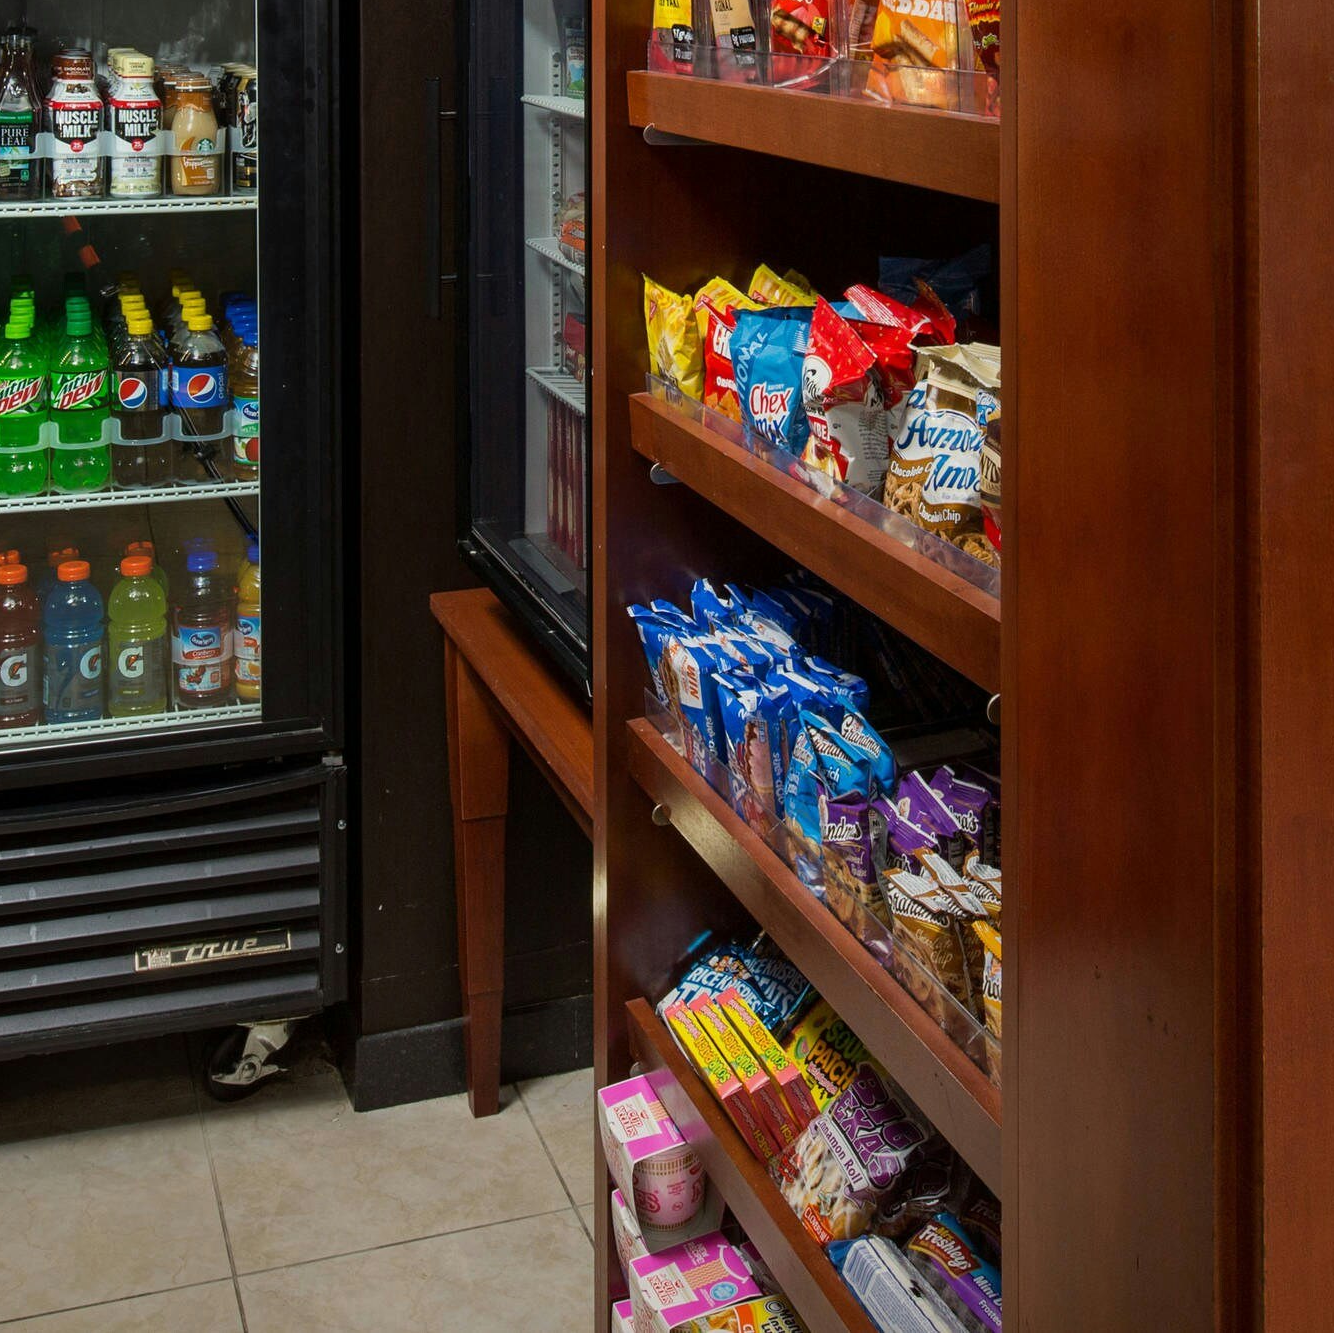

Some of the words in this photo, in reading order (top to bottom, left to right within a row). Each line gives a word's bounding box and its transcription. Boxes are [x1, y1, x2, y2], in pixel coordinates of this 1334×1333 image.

[55, 110, 99, 124] MUSCLE
[118, 109, 157, 123] MUSCLE
[124, 123, 151, 137] MILK
[1, 128, 29, 137] PURE
[1, 137, 27, 146] LEAF
[62, 124, 92, 138] MILK
[749, 383, 794, 416] Chex
[942, 508, 961, 524] Chip
[0, 653, 27, 687] G
[80, 646, 102, 679] G
[118, 646, 144, 678] G
[687, 664, 700, 701] WIN
[688, 966, 718, 987] RICE
[709, 1057, 731, 1084] SOUR
[734, 1048, 760, 1078] SOUR
[765, 1042, 789, 1071] SOUR
[808, 1040, 858, 1092] PATCH
[852, 1062, 925, 1152] BIG
[832, 1089, 902, 1188] EXAS
[844, 1158, 864, 1186] Roll
[973, 1275, 995, 1299] Mini
